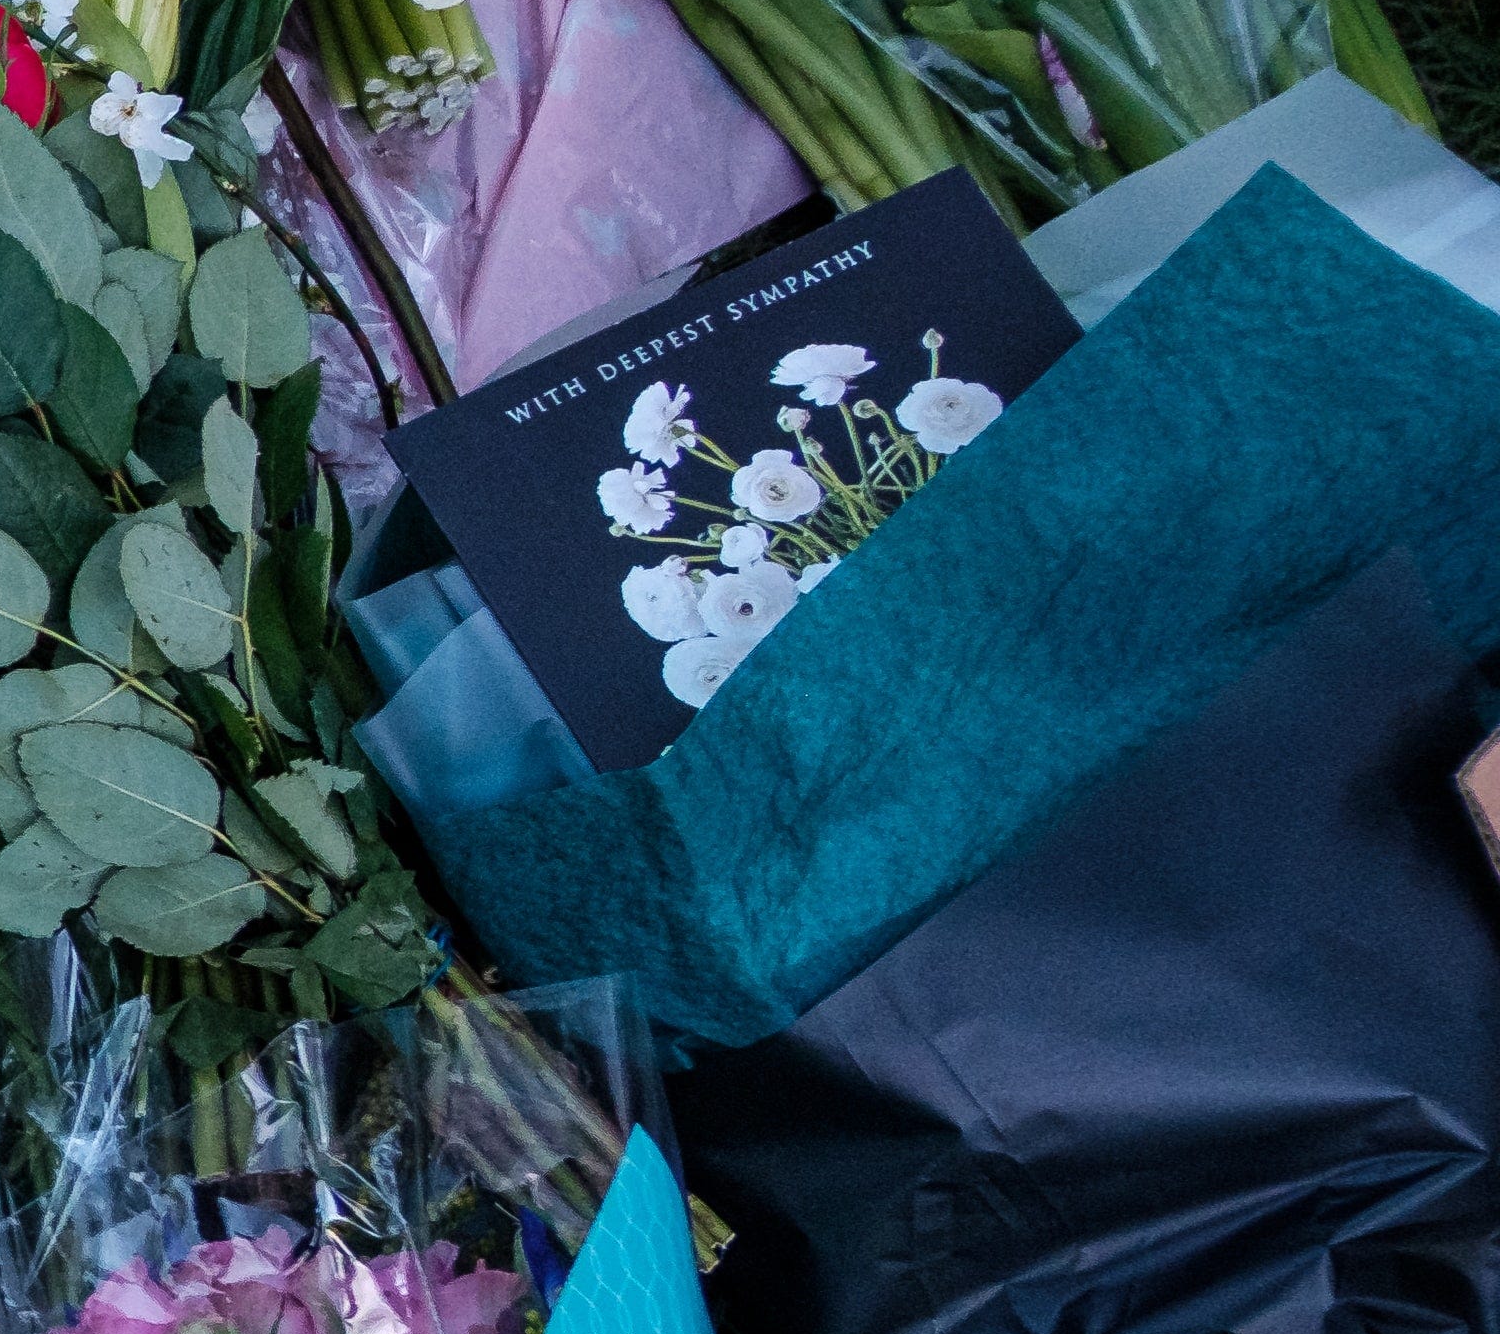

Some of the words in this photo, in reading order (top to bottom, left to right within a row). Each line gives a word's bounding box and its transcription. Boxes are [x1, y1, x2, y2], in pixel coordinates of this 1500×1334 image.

[505, 377, 588, 425] WITH
[596, 313, 718, 383] DEEPEST
[726, 239, 877, 322] SYMPATHY
